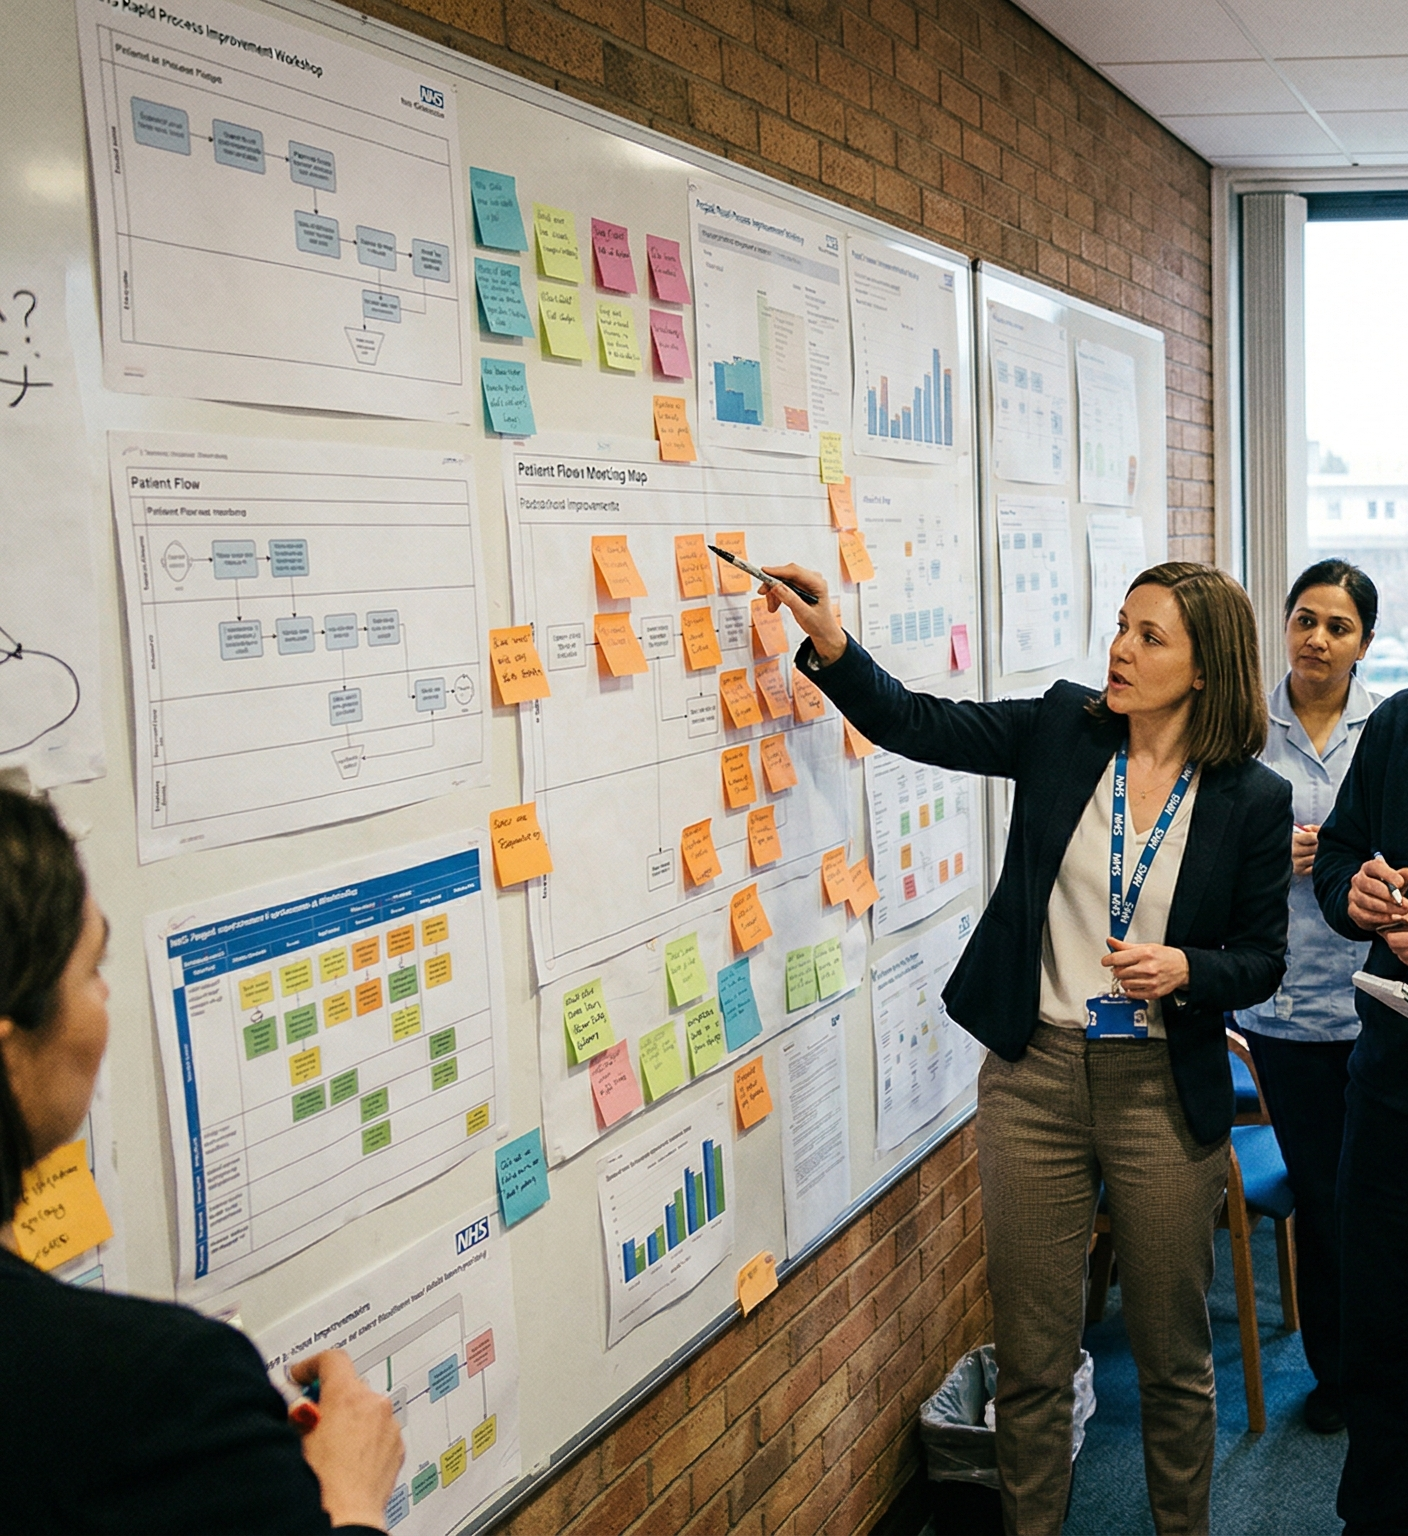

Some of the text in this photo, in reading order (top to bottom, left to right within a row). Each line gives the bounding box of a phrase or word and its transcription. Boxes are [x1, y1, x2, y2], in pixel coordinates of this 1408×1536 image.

[130, 476, 201, 490] Patient Flow
[455, 1217, 489, 1255] NHS
